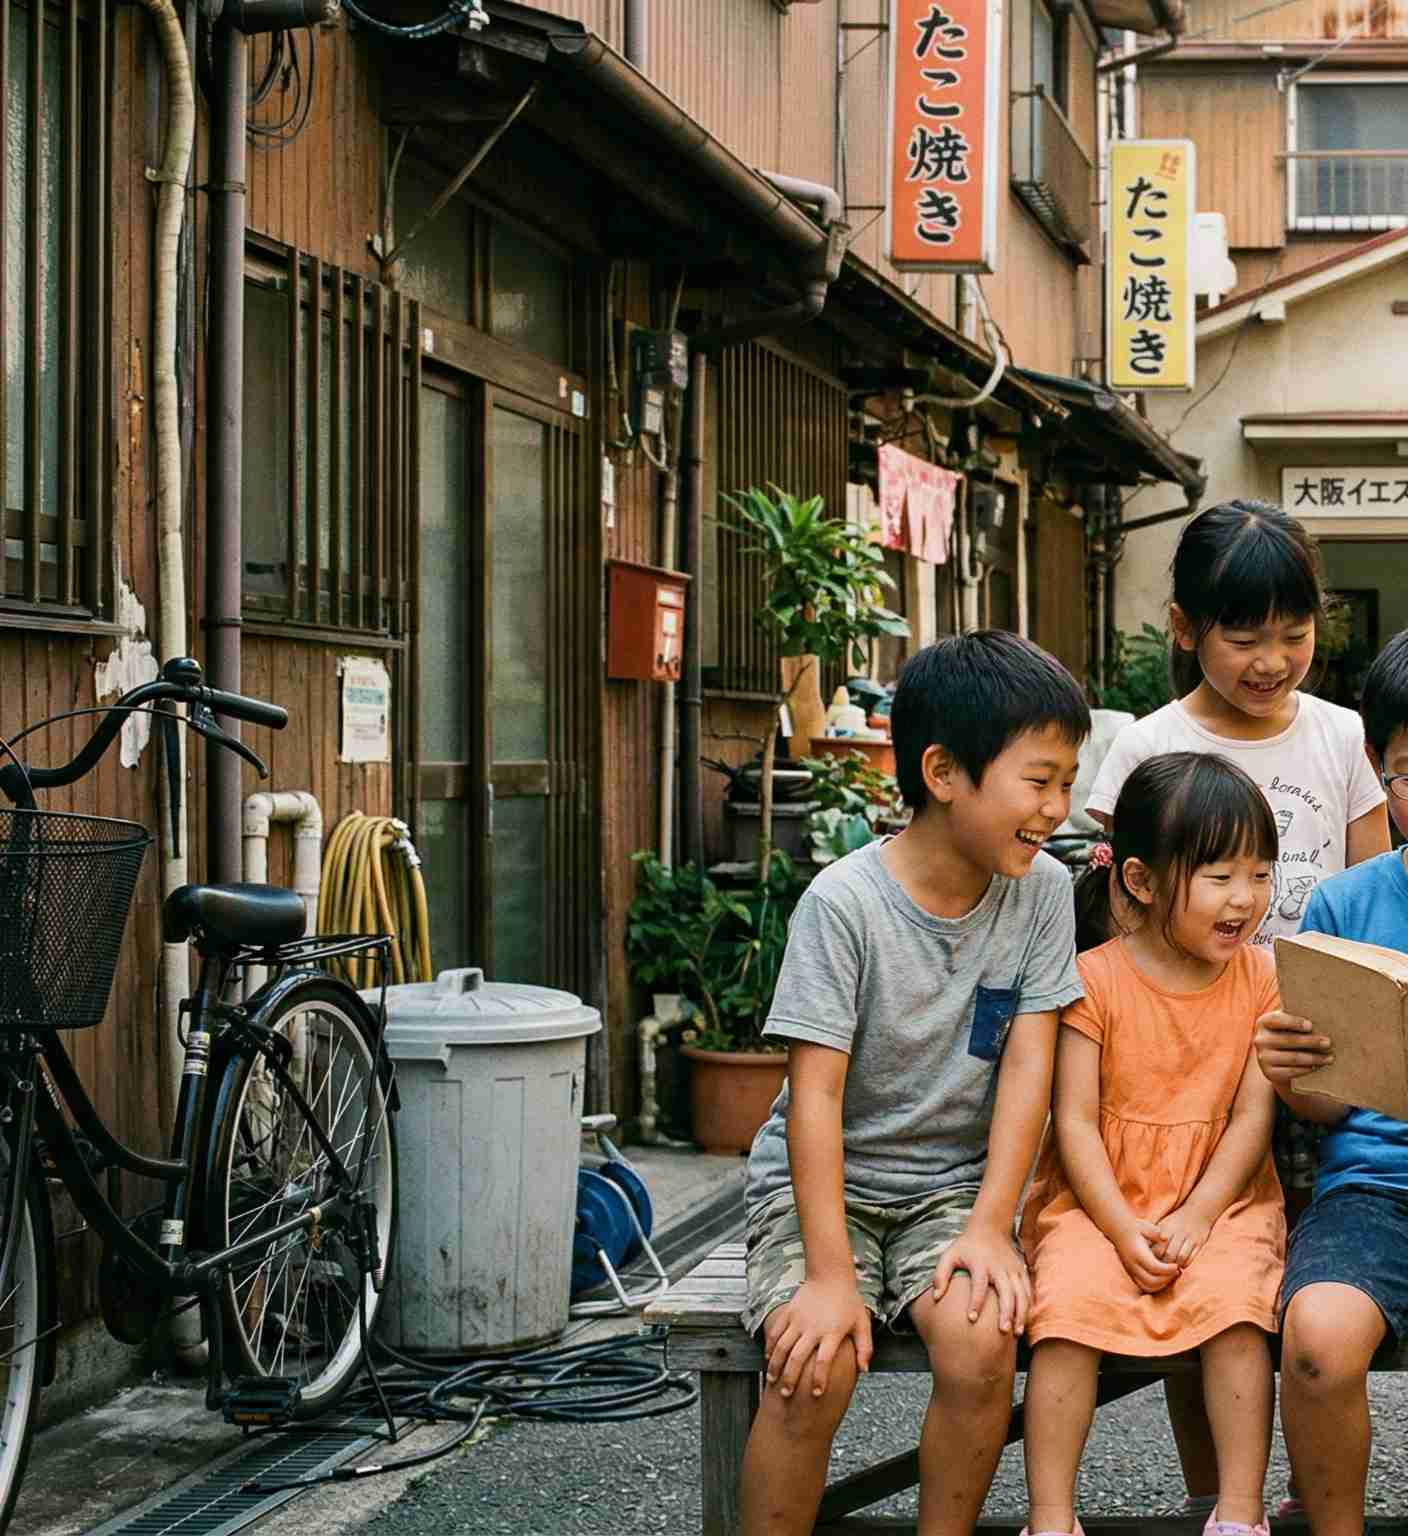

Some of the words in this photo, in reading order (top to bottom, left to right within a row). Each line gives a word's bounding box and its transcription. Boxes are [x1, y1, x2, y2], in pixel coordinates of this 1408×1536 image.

[909, 7, 969, 243] たこ焼き
[1123, 177, 1172, 375] たこ焼き
